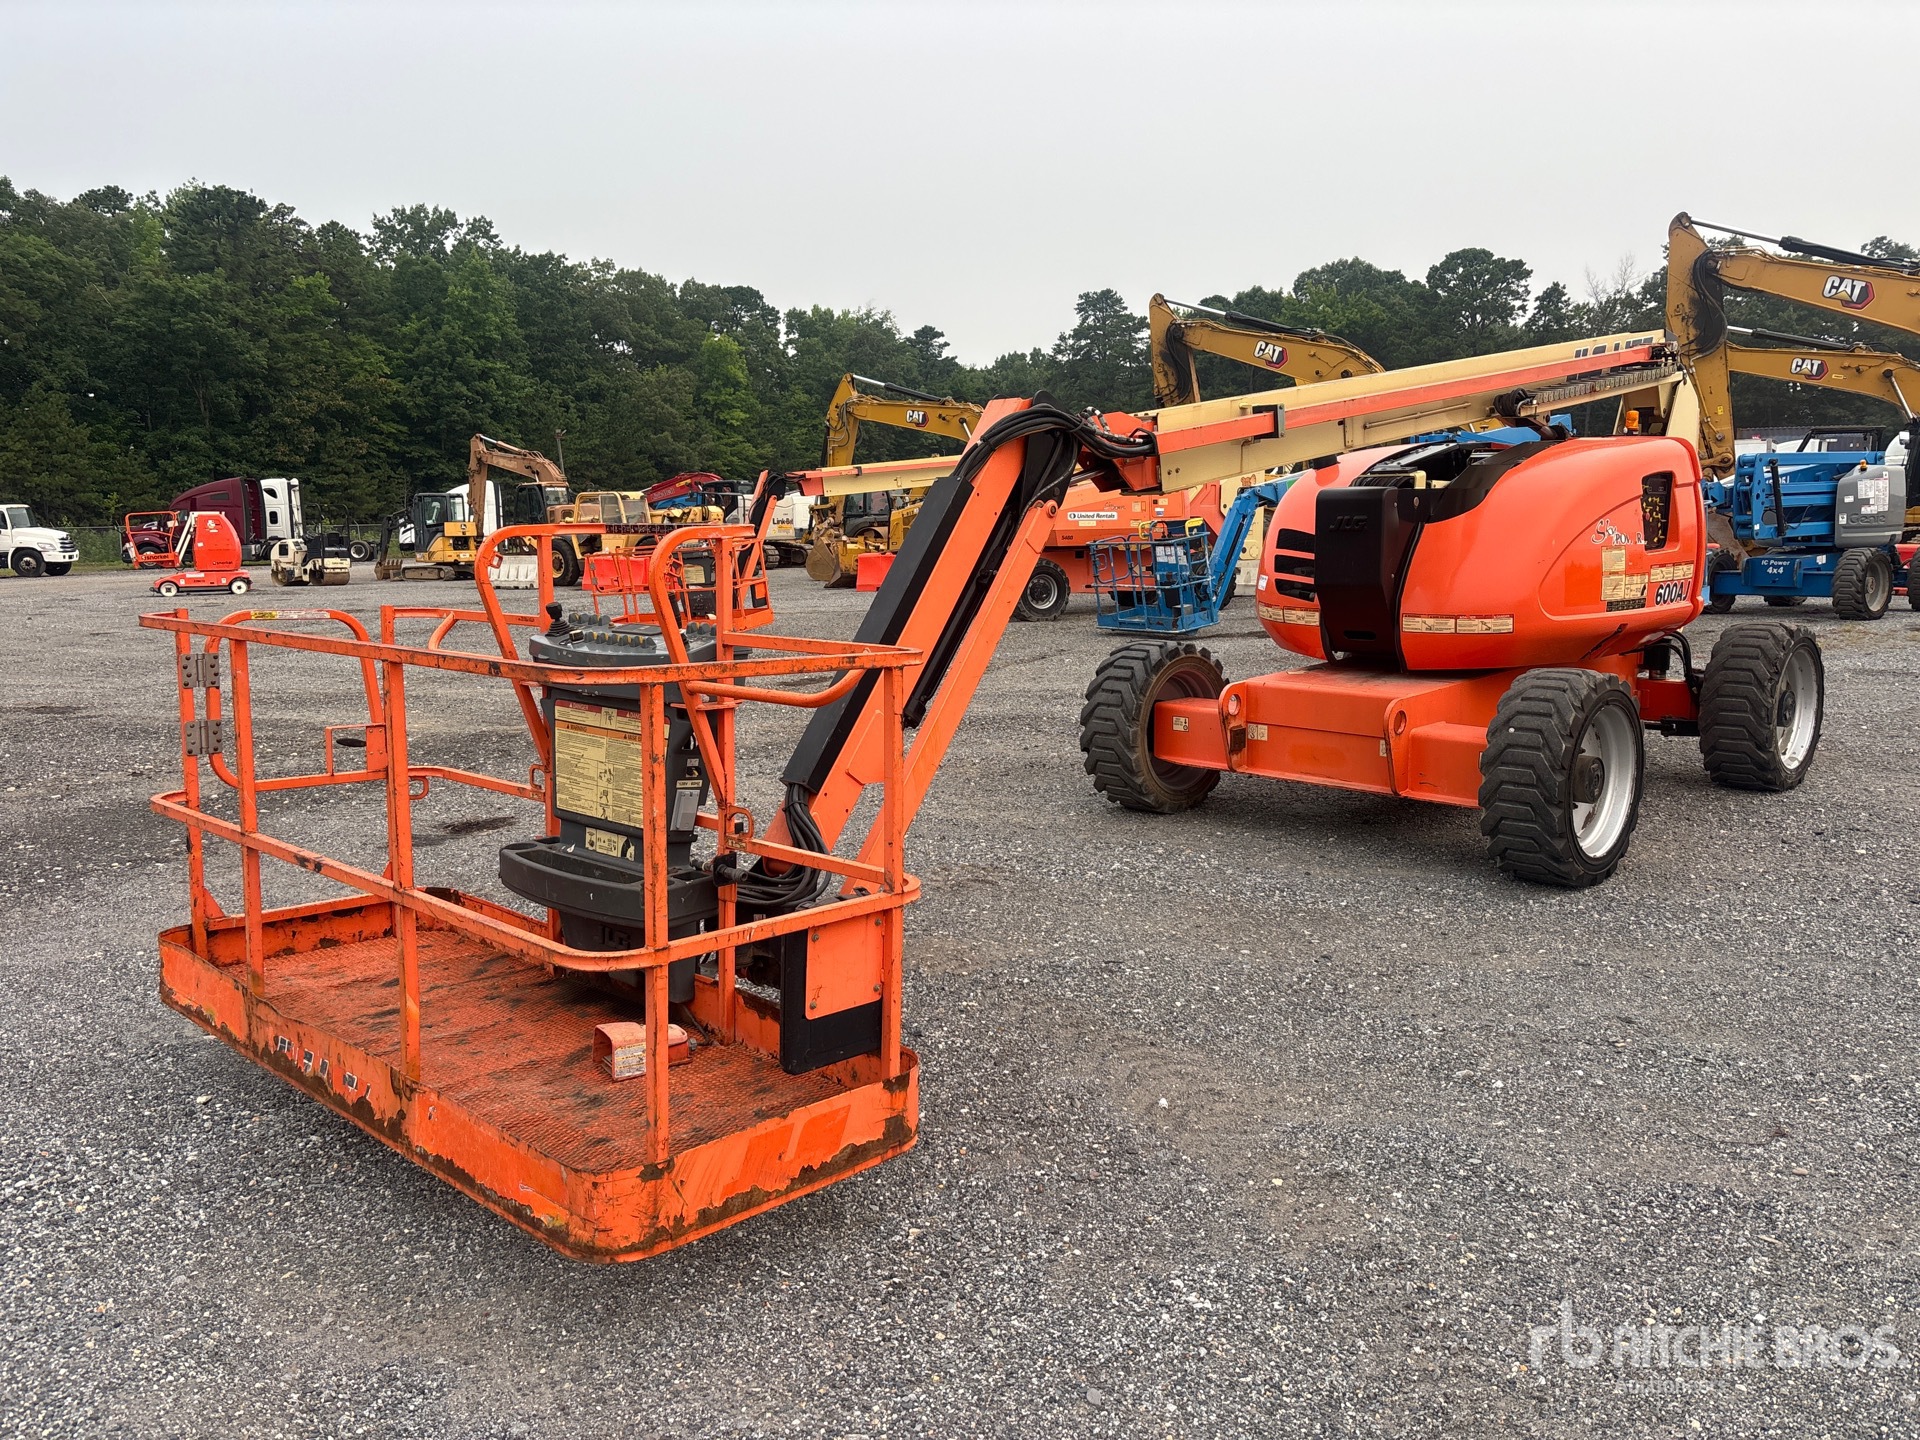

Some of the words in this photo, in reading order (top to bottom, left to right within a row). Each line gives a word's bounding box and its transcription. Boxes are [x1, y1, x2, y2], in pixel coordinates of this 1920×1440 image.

[1823, 276, 1867, 302] CAT
[1254, 340, 1283, 362] CAT
[1791, 358, 1821, 375] CAT
[906, 410, 925, 423] CAT
[1849, 513, 1886, 524] Genie
[1766, 566, 1784, 574] 4x4
[1655, 580, 1691, 606] 600AJ
